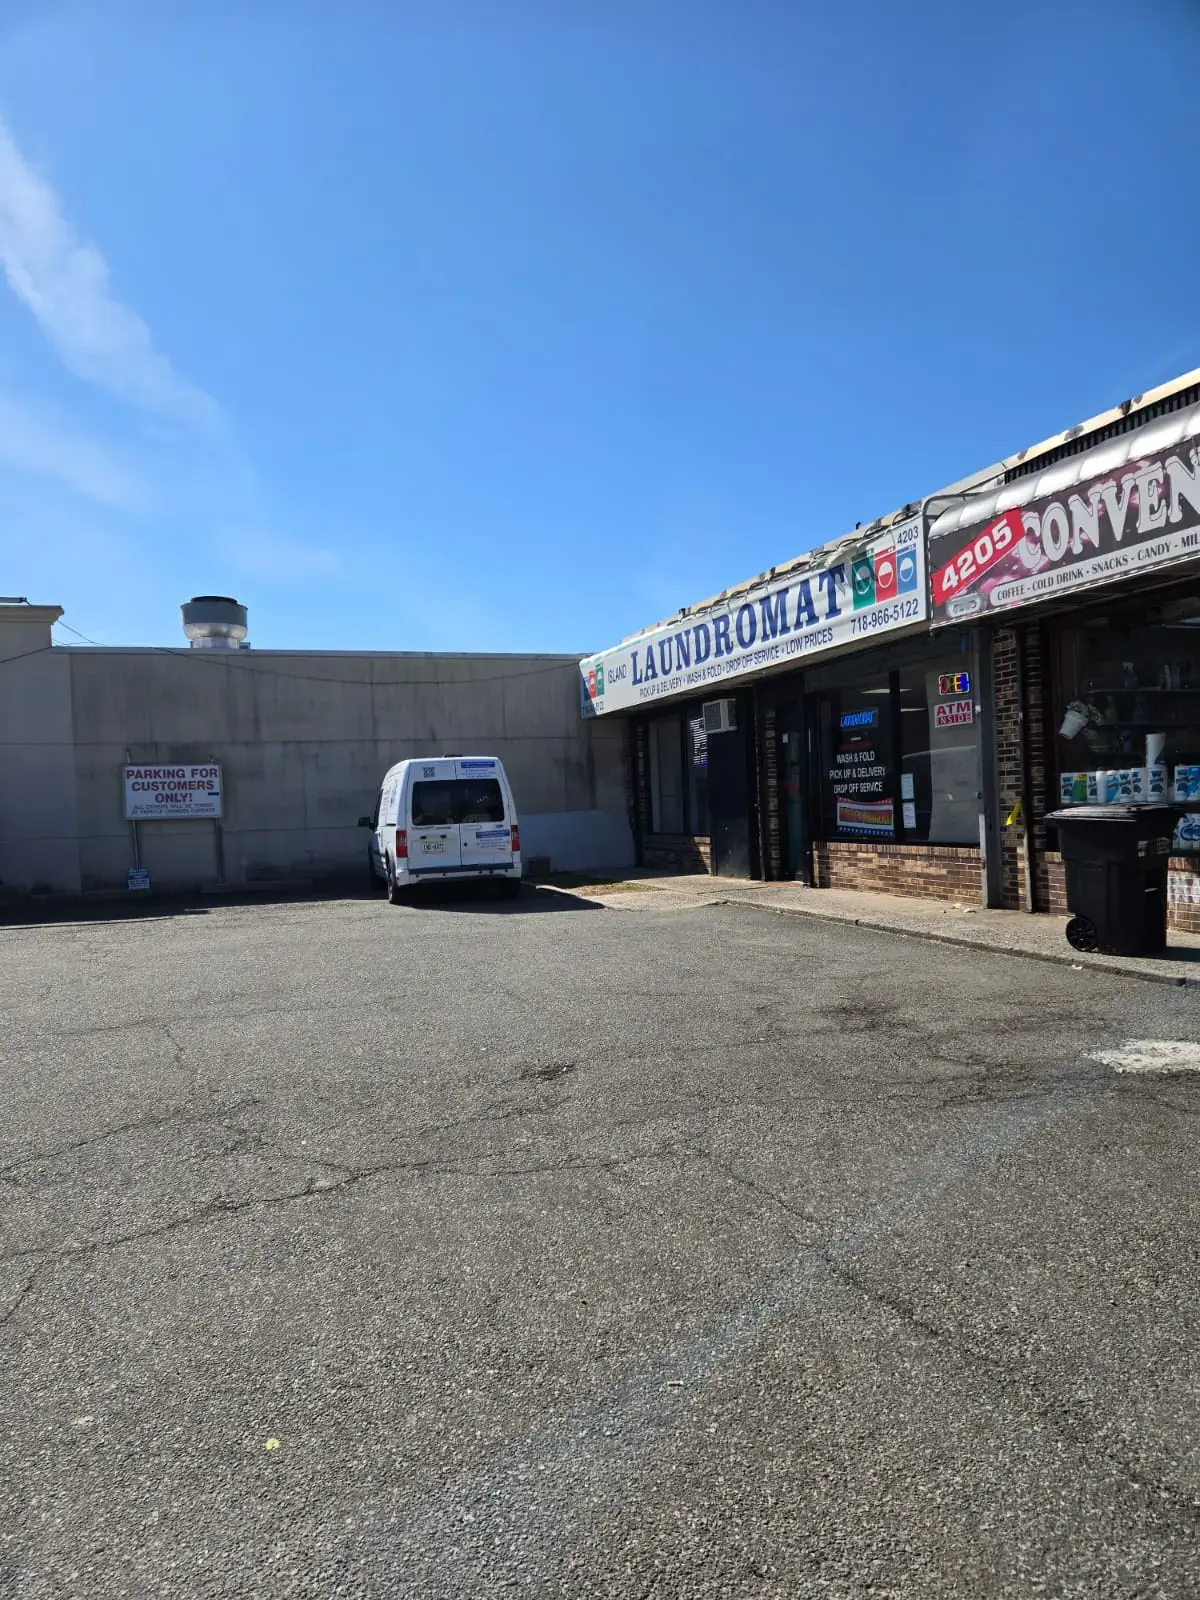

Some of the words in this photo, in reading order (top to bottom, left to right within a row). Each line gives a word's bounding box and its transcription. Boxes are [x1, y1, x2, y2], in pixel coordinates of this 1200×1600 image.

[897, 525, 919, 545] 4203
[941, 518, 1013, 593] 4205
[997, 584, 1025, 601] COFFEE
[1032, 577, 1054, 592] COLD
[1056, 568, 1084, 586] DRINK
[1091, 554, 1128, 574] SNACKS
[1137, 541, 1171, 561] CANDY
[631, 563, 845, 685] LAUNDROMAT
[850, 598, 919, 635] 718-966-5122
[639, 686, 651, 698] PICK
[660, 675, 682, 693] DELIVERY
[687, 671, 702, 685] WASH
[707, 664, 722, 679] FOLD
[726, 659, 741, 674] DROP
[741, 654, 753, 670] OFF
[754, 645, 780, 666] SERVICE
[785, 637, 804, 654] LOW
[804, 627, 833, 649] PRICES
[608, 664, 627, 684] ISLAND
[936, 701, 971, 716] ATM
[937, 713, 971, 727] INSIDE
[836, 752, 853, 764] WASH
[854, 752, 859, 763] &
[859, 751, 875, 762] FOLD
[126, 769, 186, 780] PARKING
[190, 768, 218, 778] FOR
[829, 768, 842, 780] PICK
[843, 768, 851, 778] UP
[857, 766, 886, 778] DELIVERY
[131, 780, 214, 792] CUSTOMERS
[834, 783, 848, 793] DROP
[848, 782, 859, 793] OFF
[860, 781, 883, 792] SERVICE
[155, 792, 193, 803] ONLY!
